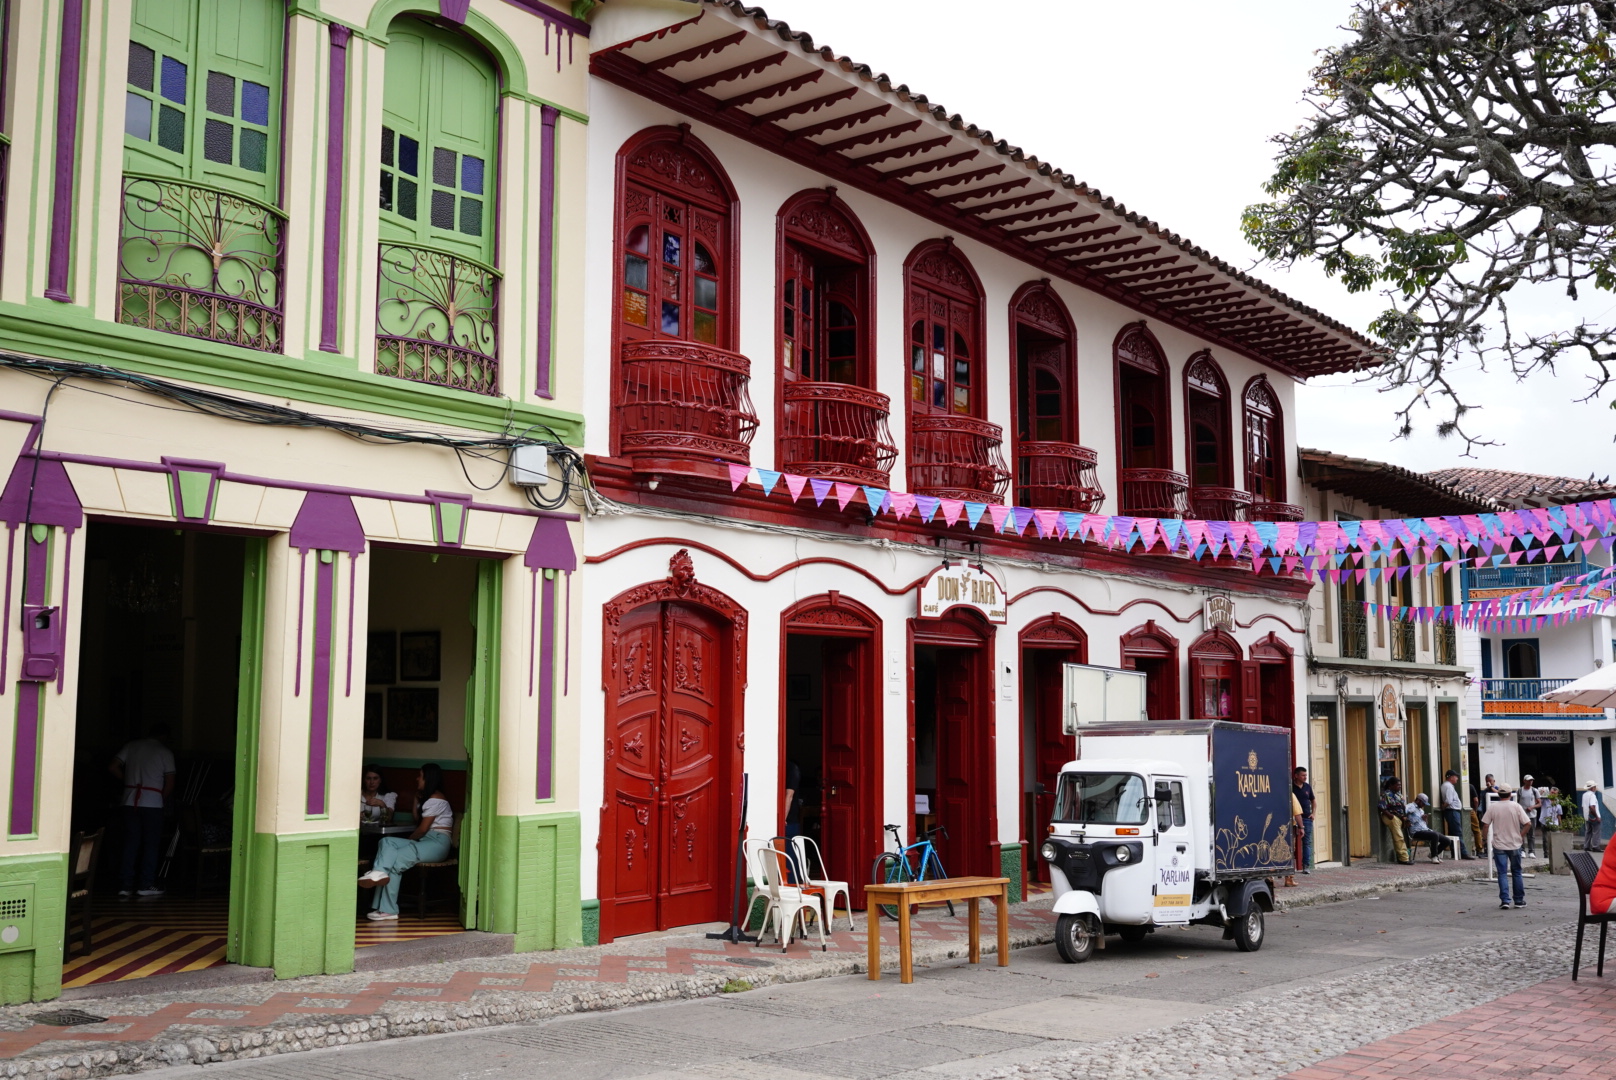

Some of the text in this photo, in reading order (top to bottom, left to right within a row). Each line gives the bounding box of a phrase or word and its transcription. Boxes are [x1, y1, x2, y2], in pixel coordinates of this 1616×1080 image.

[937, 575, 996, 605] DON RAFA
[923, 602, 939, 613] CAFÉ
[1235, 770, 1271, 798] KARLINA
[1160, 868, 1190, 886] KARLINA
